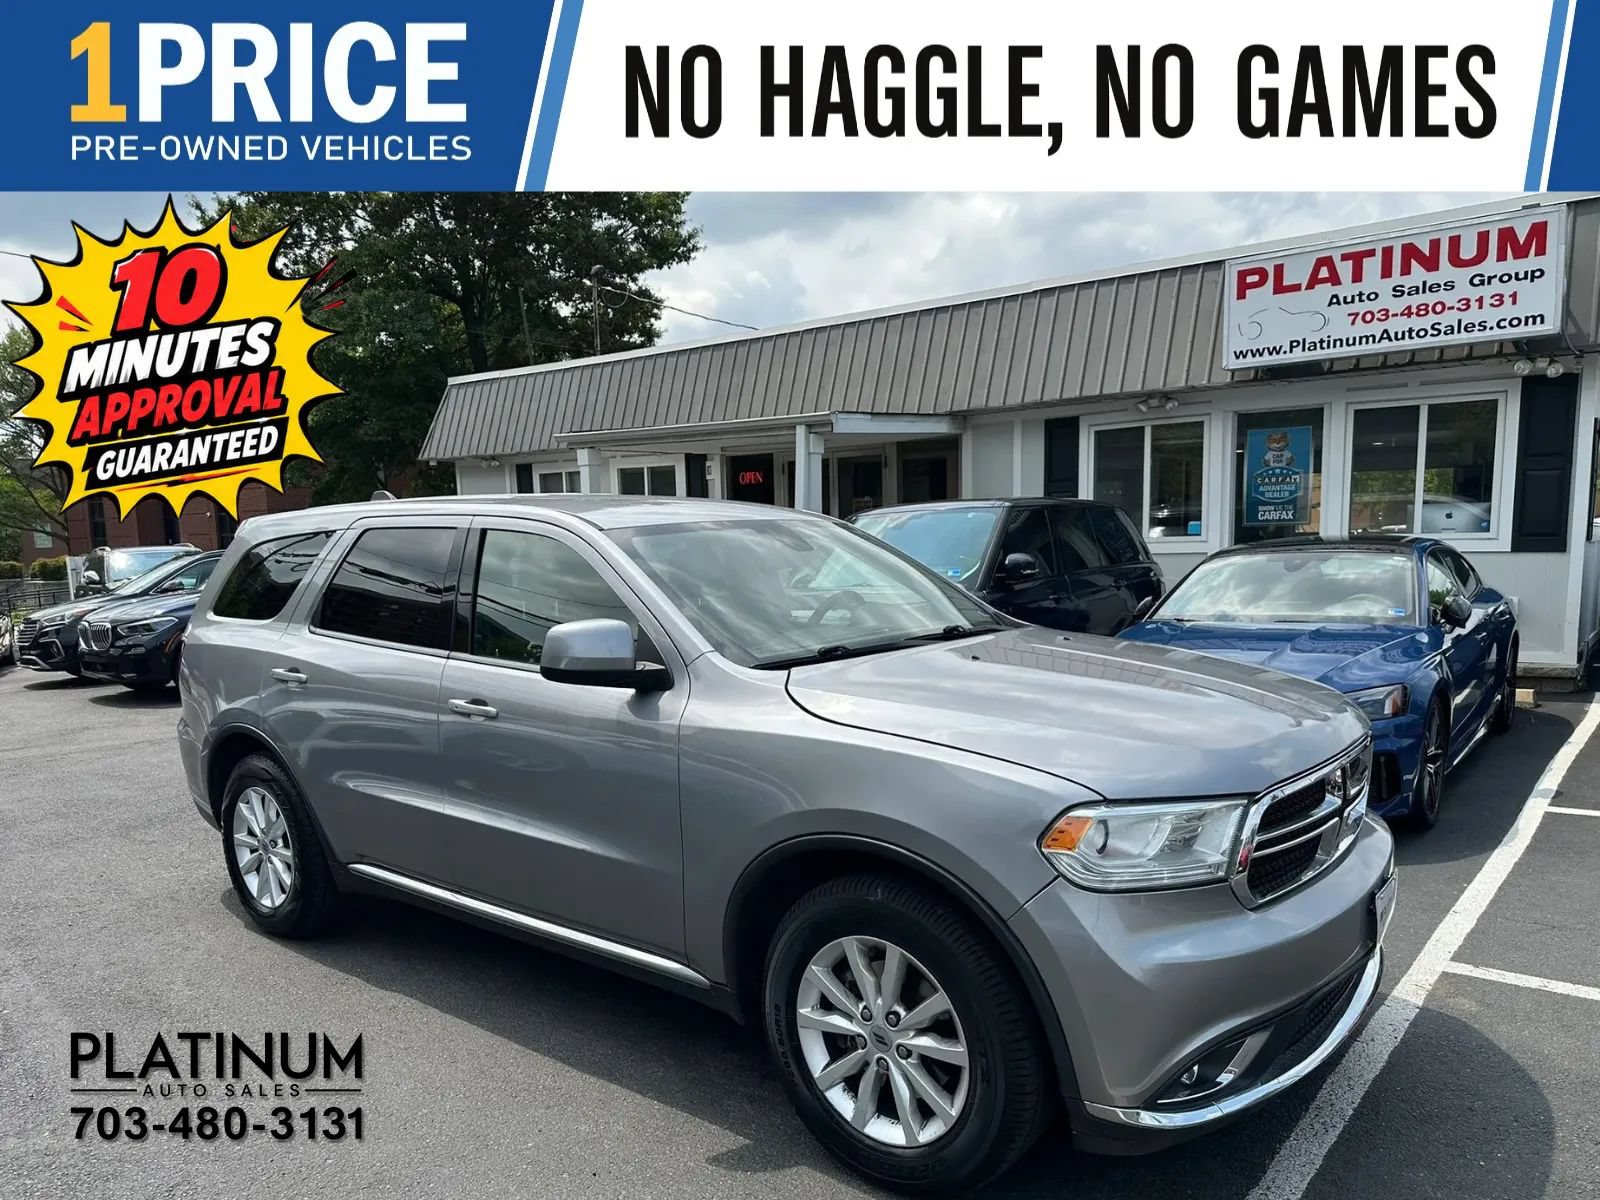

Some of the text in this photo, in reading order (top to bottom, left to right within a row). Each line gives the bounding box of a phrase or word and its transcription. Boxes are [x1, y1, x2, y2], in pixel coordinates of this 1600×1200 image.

[1236, 221, 1547, 300] PLATINUM
[1327, 268, 1545, 307] Auto Sales Group
[1347, 291, 1518, 326] 703-480-3131
[1233, 313, 1545, 360] www.PlatinumAutoSales.com
[740, 471, 763, 485] OPEN
[1257, 475, 1300, 484] CARFAX
[1259, 484, 1296, 492] ADVANTAGE
[1258, 511, 1294, 520] CARFAX
